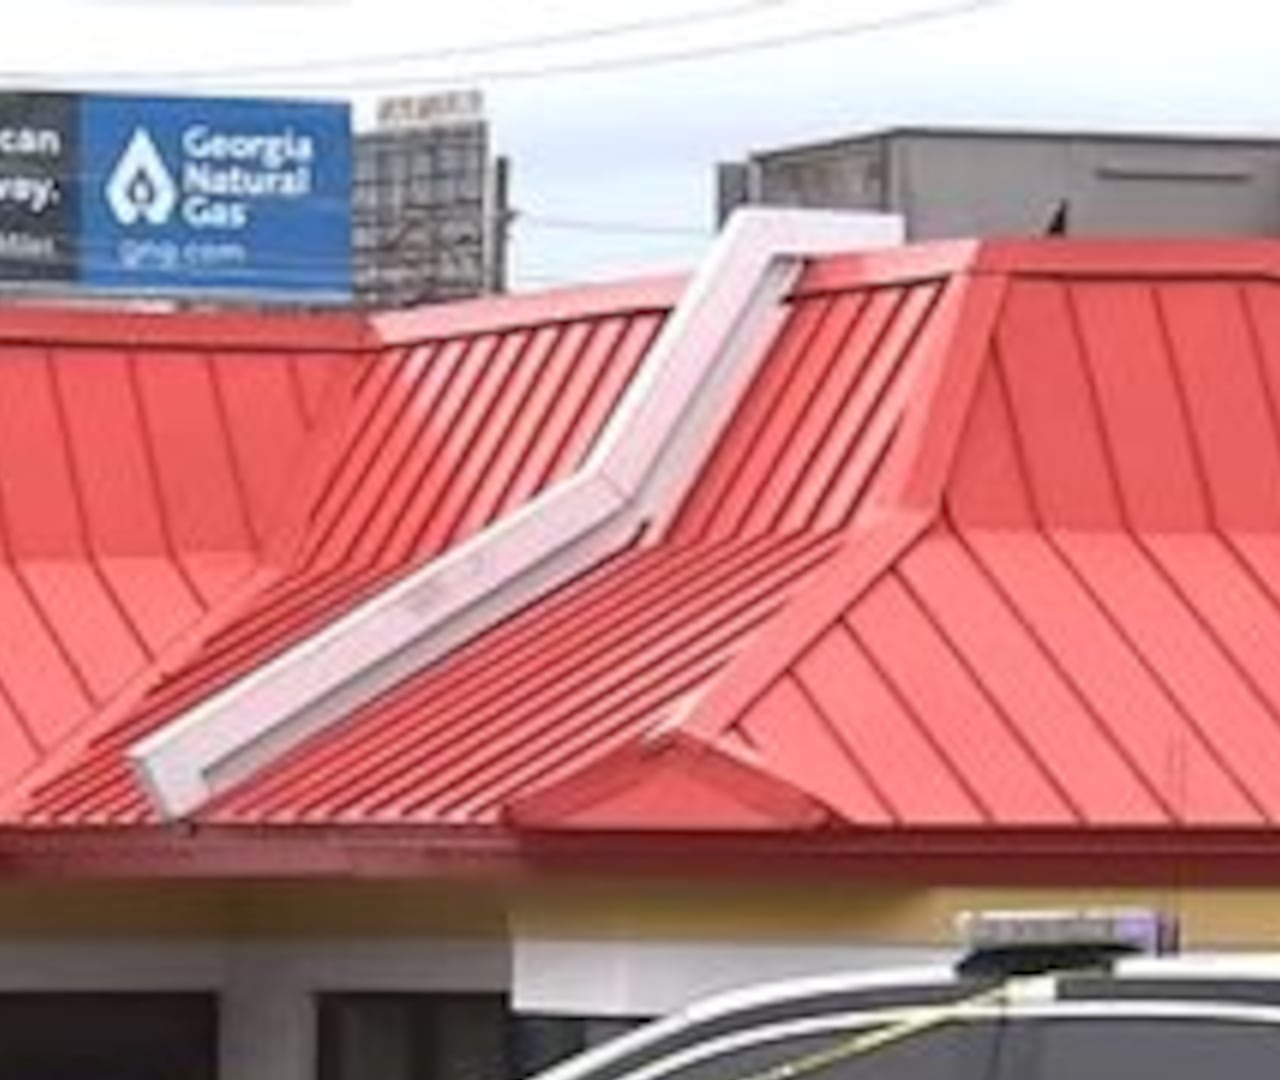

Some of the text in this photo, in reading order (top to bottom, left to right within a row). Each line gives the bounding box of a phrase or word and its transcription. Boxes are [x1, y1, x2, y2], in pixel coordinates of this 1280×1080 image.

[181, 124, 312, 169] Georgia
[182, 161, 311, 195] Natural
[181, 196, 247, 228] Gas
